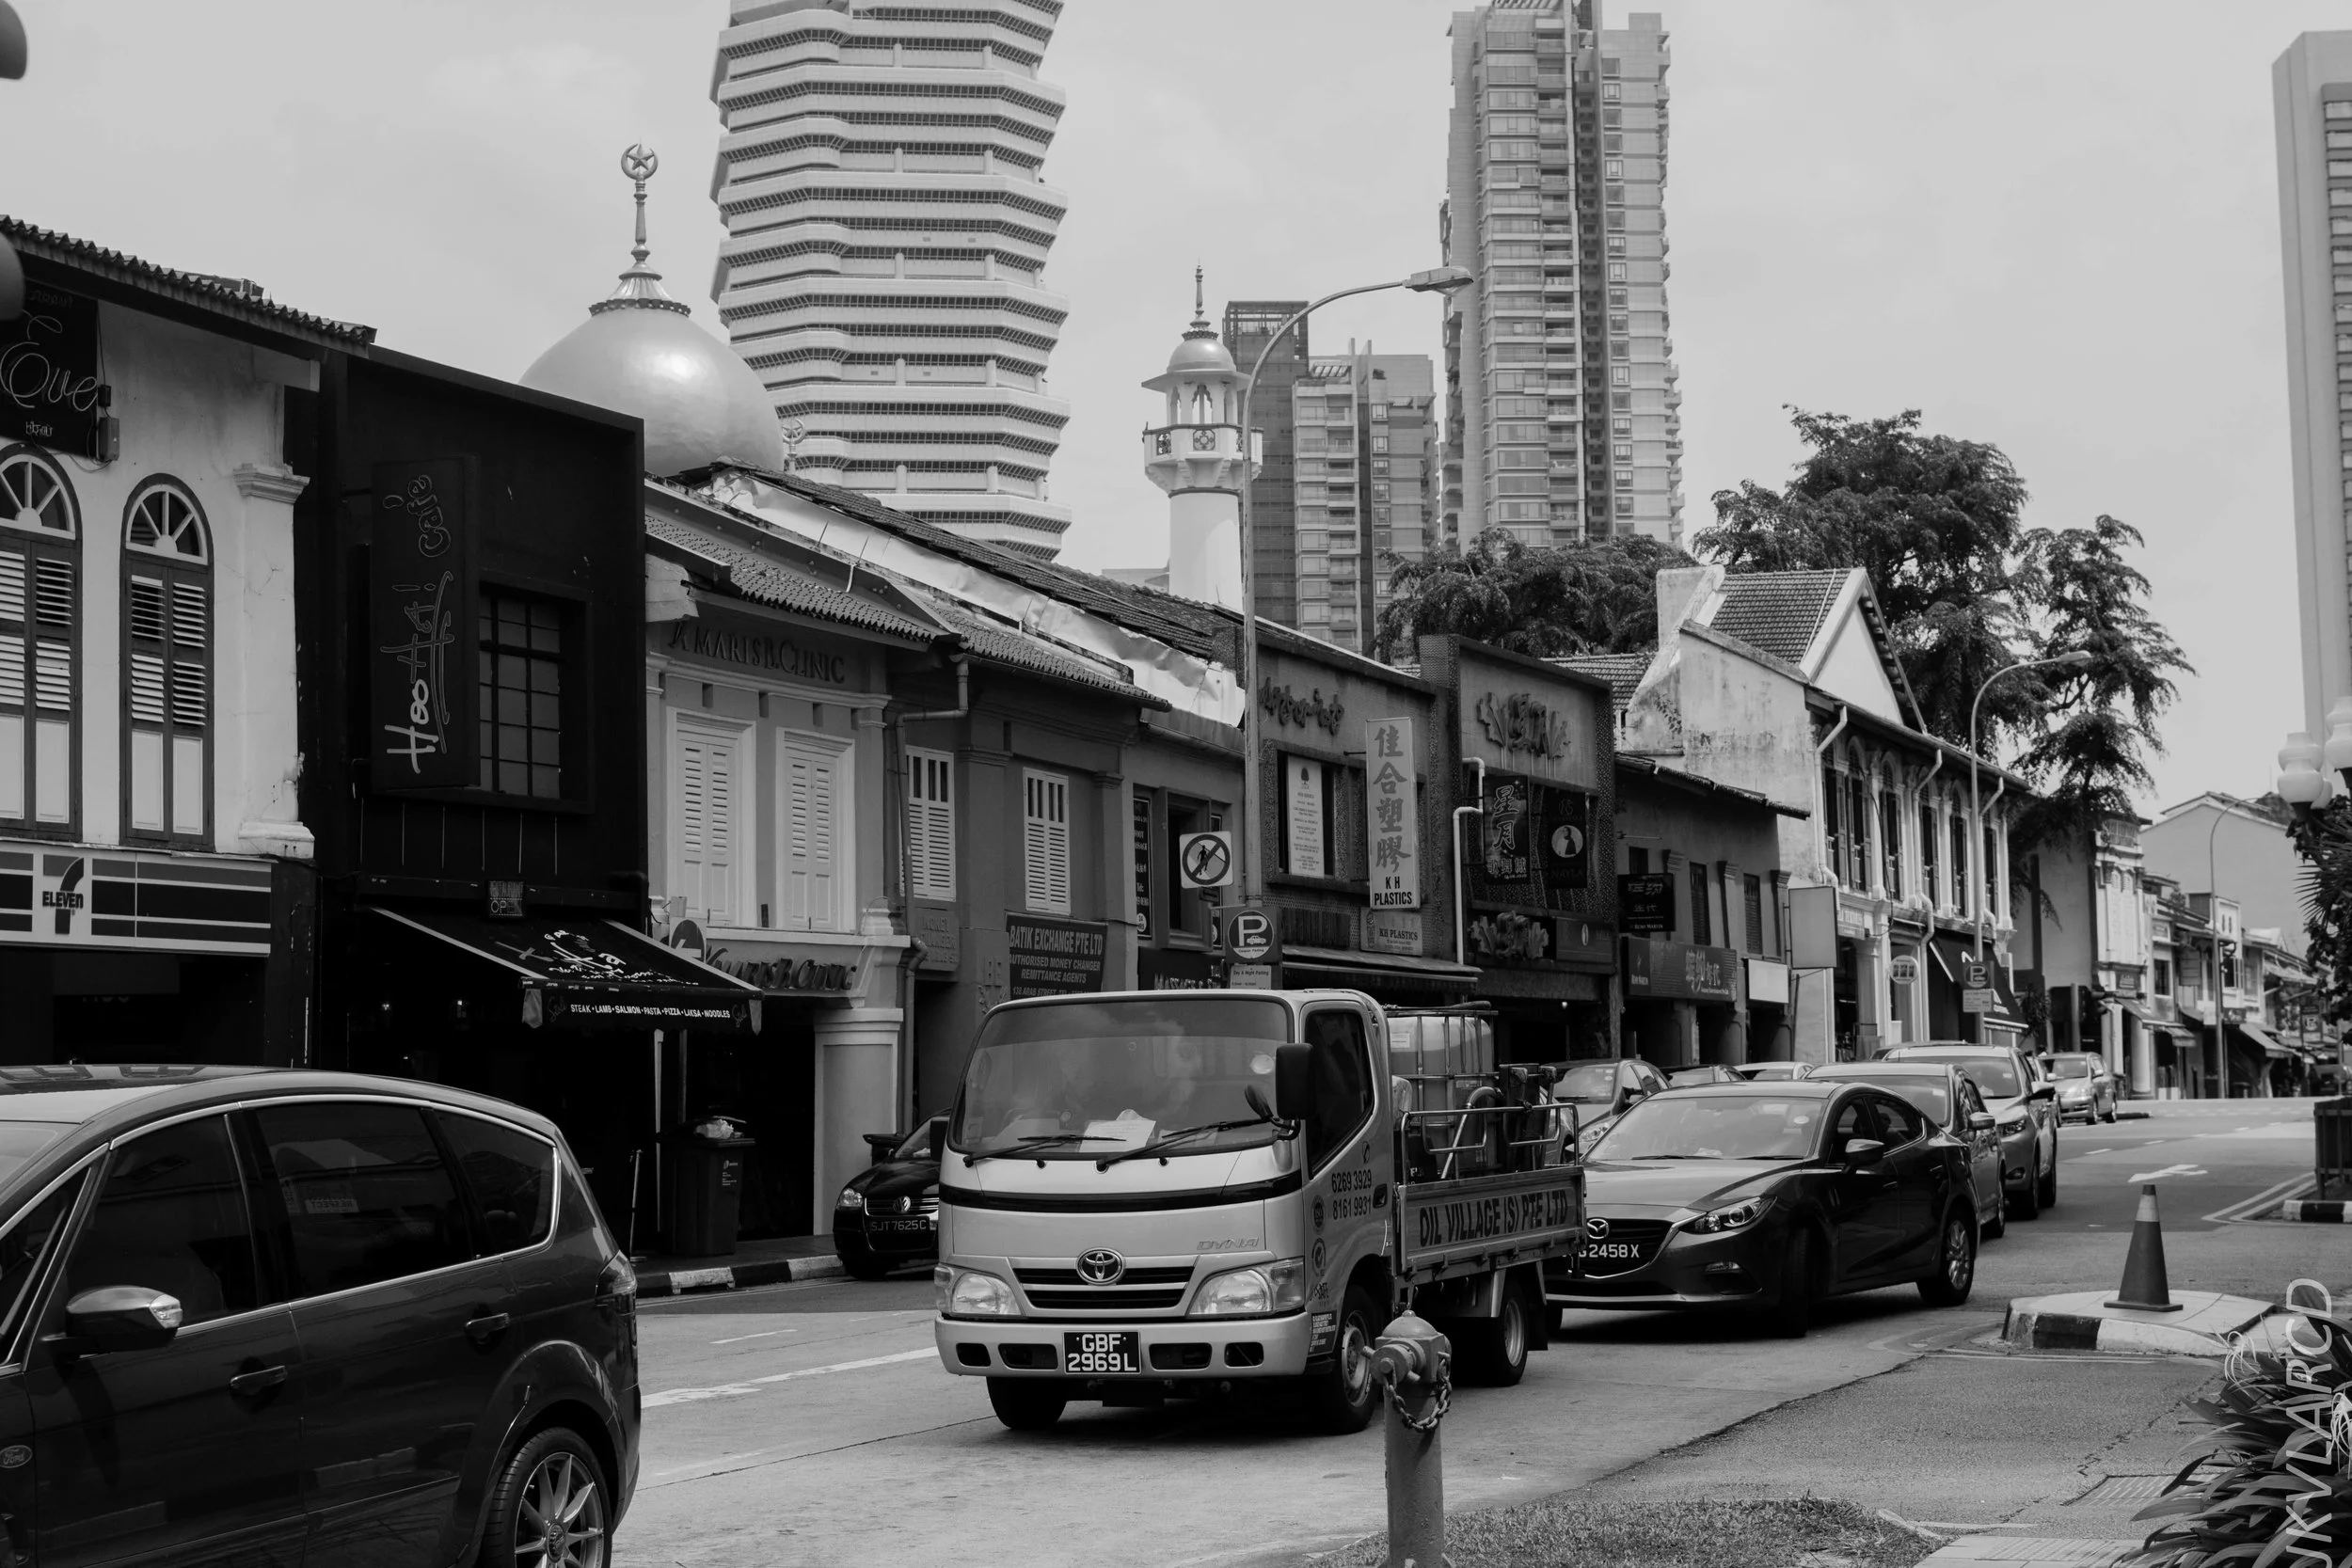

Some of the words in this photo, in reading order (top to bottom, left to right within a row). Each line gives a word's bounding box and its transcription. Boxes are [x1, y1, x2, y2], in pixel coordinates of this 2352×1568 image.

[779, 640, 845, 684] CLINIC
[1374, 724, 1411, 873] 佳合塑膠
[1494, 784, 1519, 850] 星月
[490, 900, 523, 913] OPEN
[1375, 892, 1412, 906] PLASTICS
[1009, 925, 1033, 949] BATIK
[1034, 927, 1074, 954] EXCHANGE
[1075, 932, 1089, 954] PTE
[1089, 934, 1104, 956] LTD
[1379, 927, 1389, 937] KH
[1390, 929, 1419, 941] PLASTICS
[1009, 954, 1049, 968] AUTHORISED
[1050, 958, 1073, 969] MONEY
[1073, 959, 1101, 972] CHANGER
[1021, 969, 1061, 983] REMITTANCE
[1062, 972, 1088, 984] AGENTS
[570, 1004, 592, 1013] STEAK
[595, 1005, 612, 1014] LAMB
[614, 1005, 642, 1014] SALMON
[644, 1006, 661, 1015] PASTA
[663, 1007, 681, 1016] PIZZA
[683, 1008, 702, 1017] LAKSA
[704, 1009, 731, 1019] NOODLES
[1331, 1172, 1352, 1193] 6269
[1353, 1168, 1373, 1190] 3929
[1332, 1198, 1352, 1220] 8161
[1353, 1195, 1373, 1217] 9931
[870, 1219, 927, 1231] SJT7625C
[1420, 1206, 1442, 1247] OIL
[1445, 1197, 1500, 1243] VILLAGE
[1521, 1192, 1543, 1231] PTE
[1546, 1188, 1568, 1227] LTD
[1196, 1236, 1260, 1251] DYNA
[1082, 1334, 1121, 1353] GBF
[1068, 1353, 1137, 1372] 2969L
